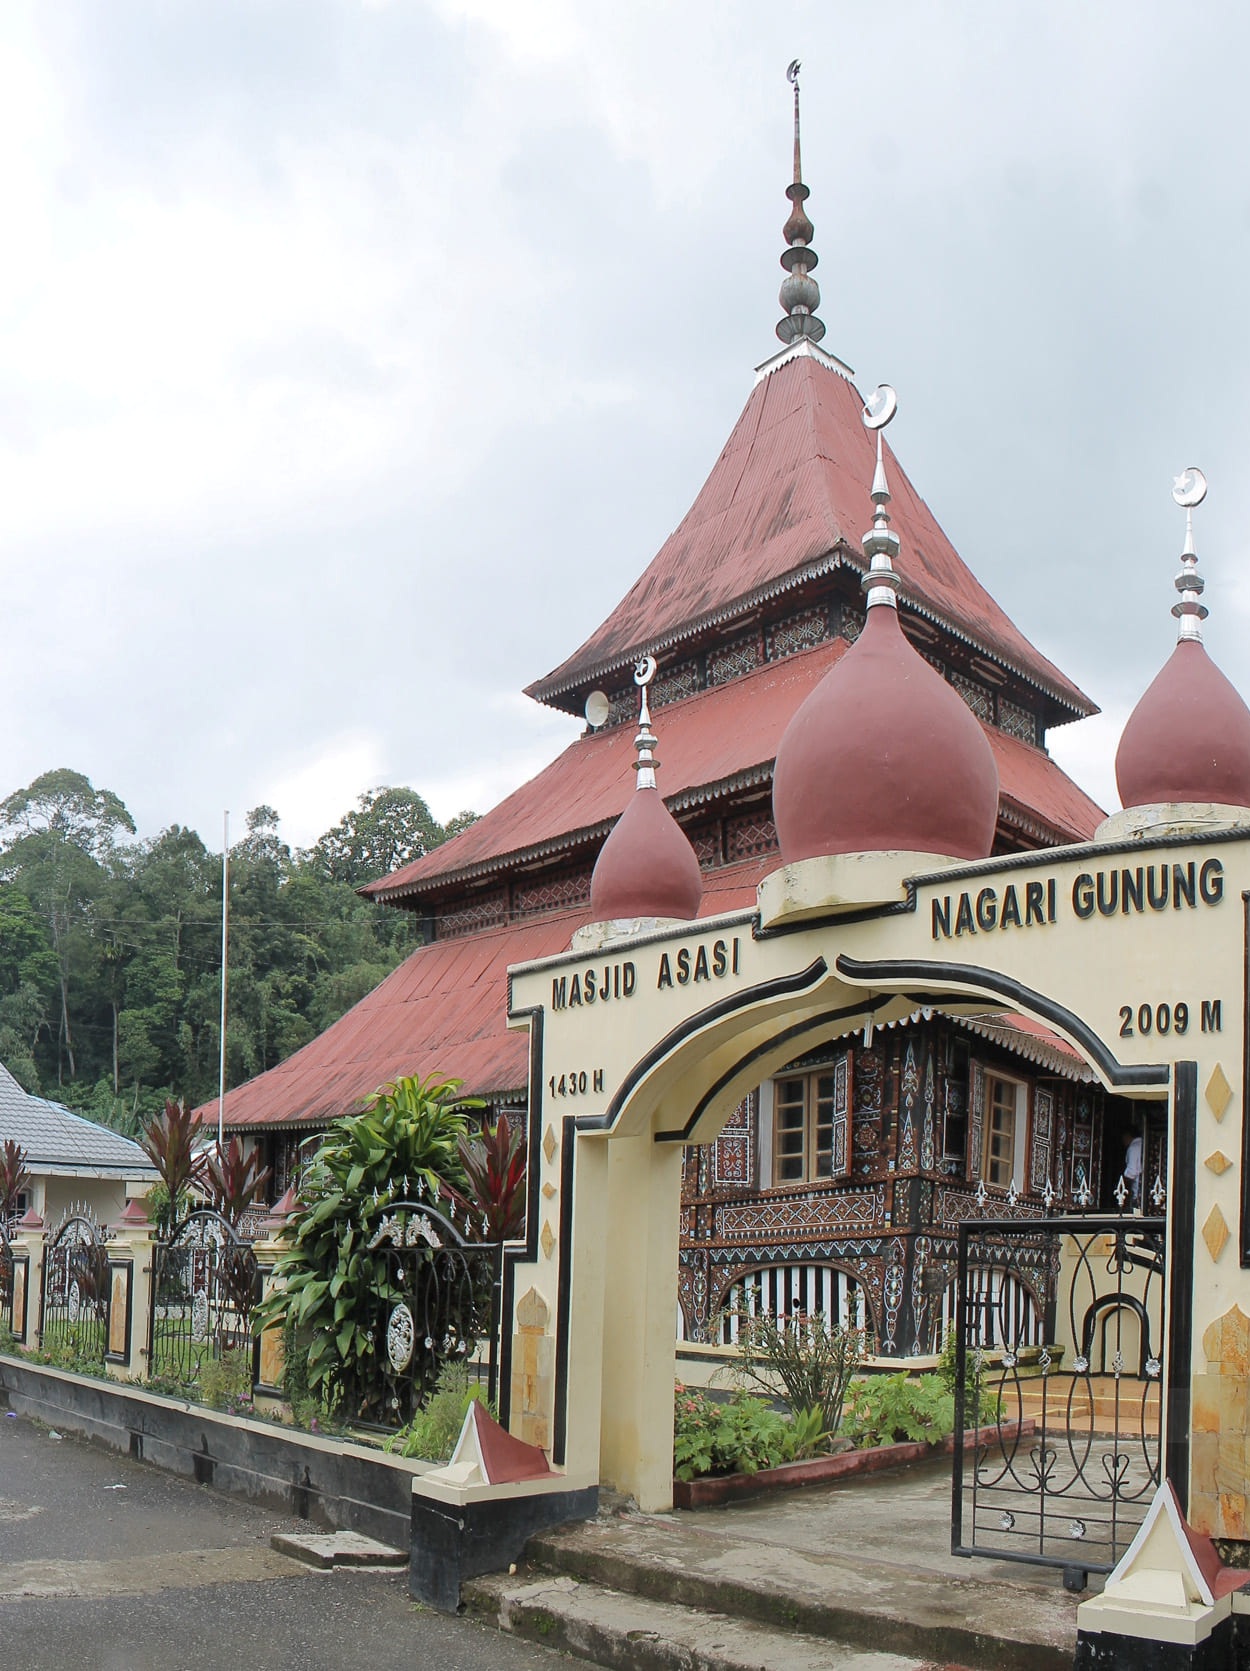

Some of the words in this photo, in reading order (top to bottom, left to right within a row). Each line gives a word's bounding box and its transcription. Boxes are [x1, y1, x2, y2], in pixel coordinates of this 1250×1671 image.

[552, 961, 637, 1011] MASJID
[657, 937, 740, 990] ASASI
[931, 878, 1057, 940] NAGARI
[1072, 858, 1225, 920] GUNUNG
[1119, 1002, 1189, 1038] 2009
[1201, 999, 1222, 1034] M
[549, 1070, 587, 1098] 1430
[593, 1068, 605, 1093] H
